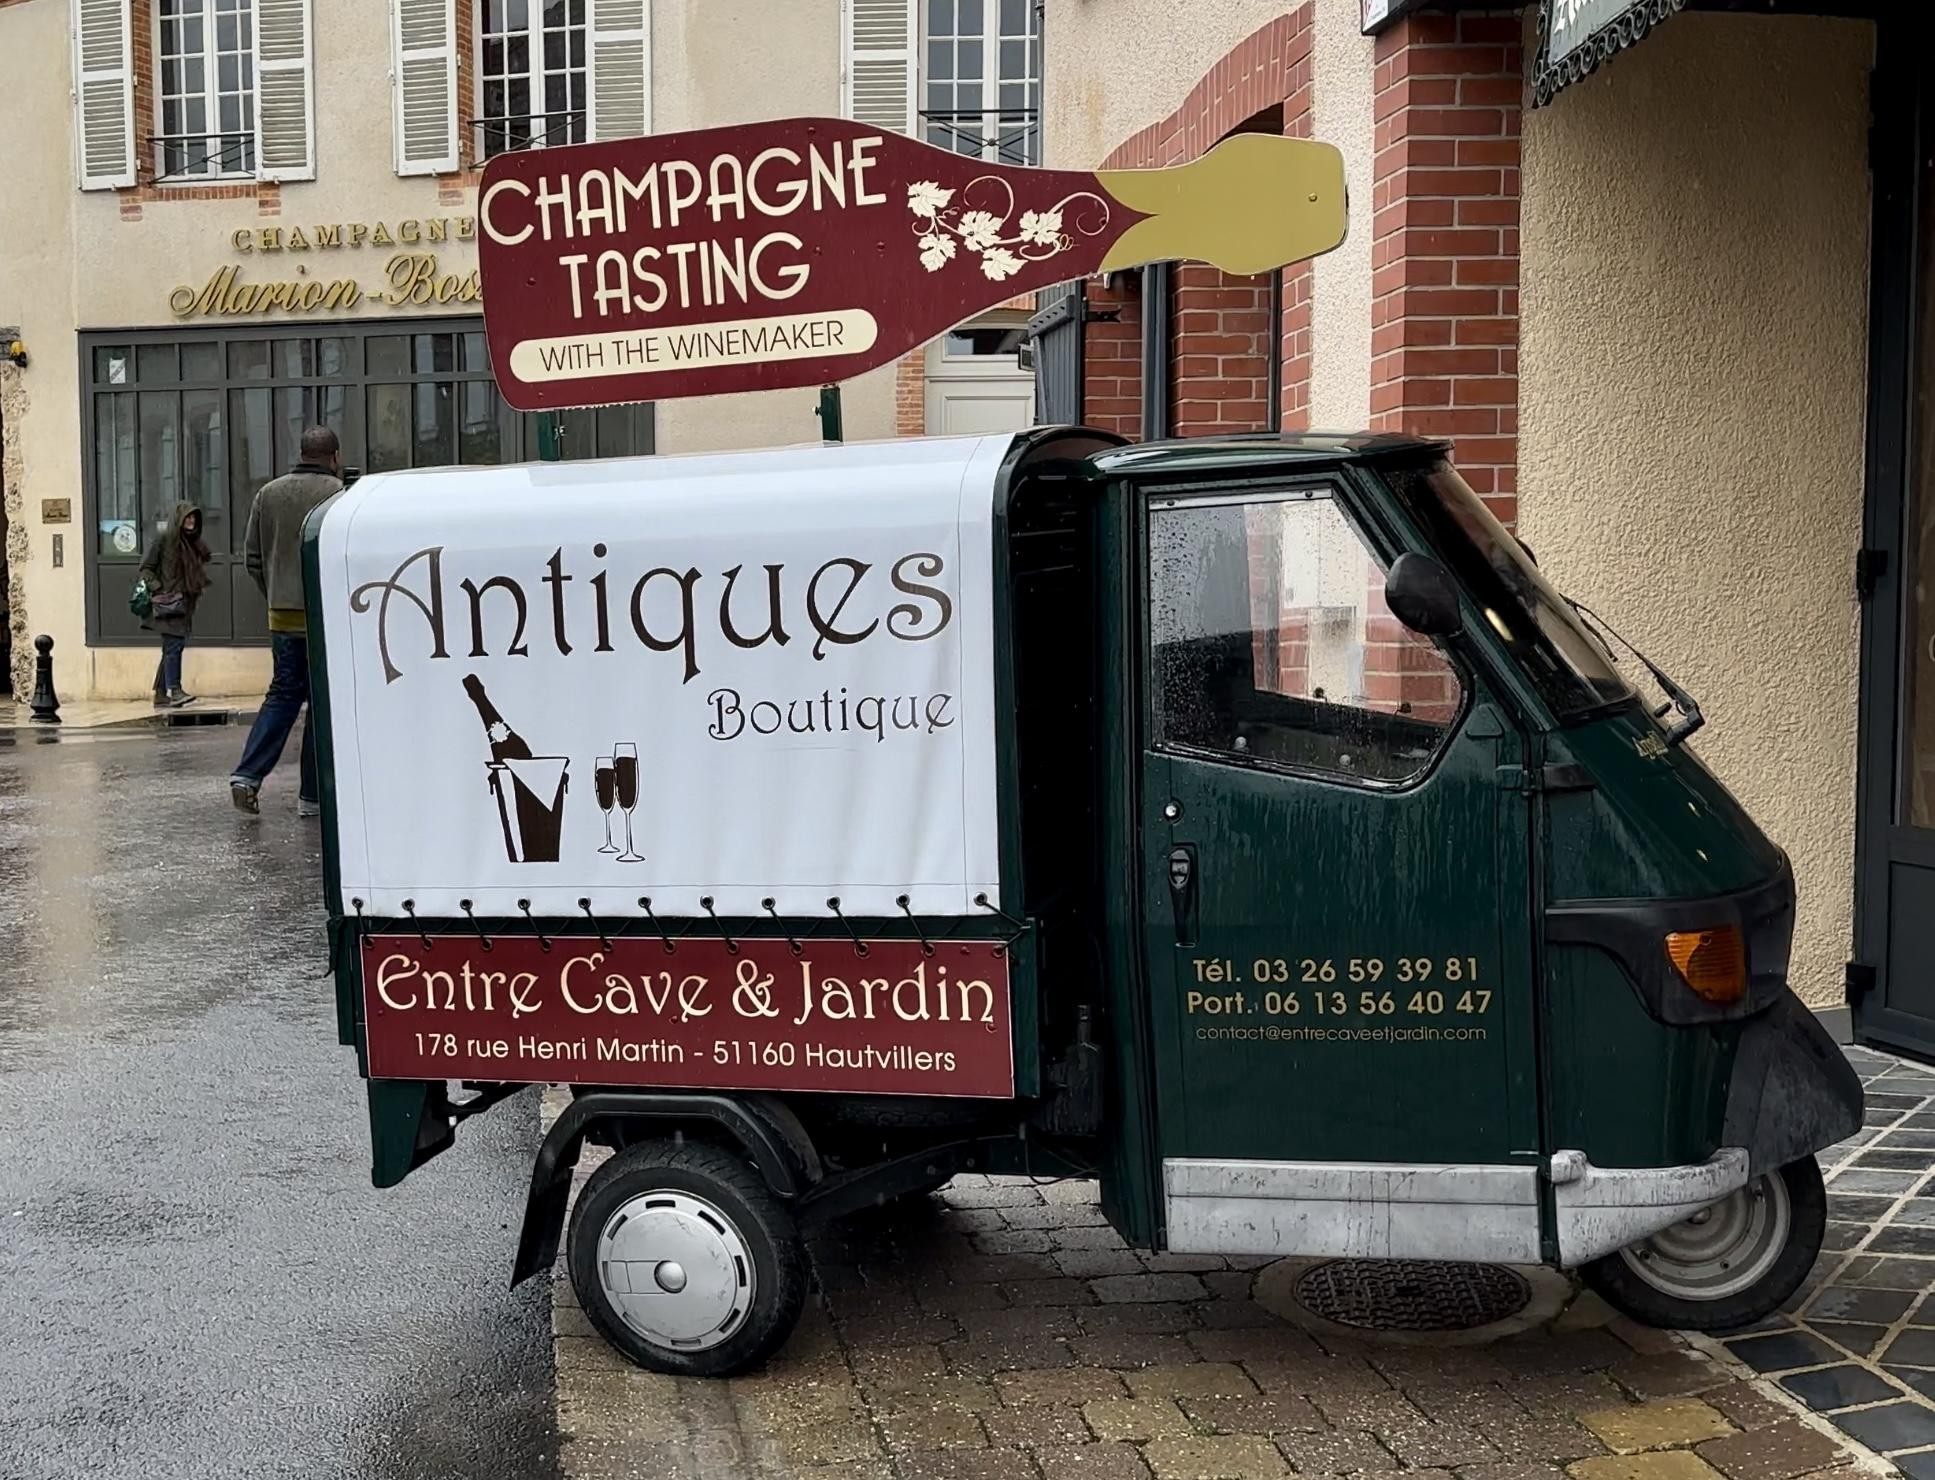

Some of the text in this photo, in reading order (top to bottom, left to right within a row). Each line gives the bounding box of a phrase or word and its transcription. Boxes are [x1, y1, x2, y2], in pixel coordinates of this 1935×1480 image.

[480, 136, 887, 246] CHAMPAGNE
[231, 216, 476, 250] CHAMPAGNE
[558, 231, 810, 319] TASTING
[539, 320, 844, 372] WITH THE WINEMAKER
[350, 542, 952, 685] Antiques
[706, 687, 955, 743] Boutique
[376, 952, 994, 1025] Entre Cave & Jardin
[1192, 957, 1477, 983] Tél. 03 26 59 39 81
[1187, 990, 1492, 1015] Port. 06 13 56 40 47
[415, 1033, 458, 1057] 178
[467, 1039, 509, 1058] rue
[518, 1035, 587, 1060] Henri
[596, 1037, 684, 1063] Martin
[713, 1040, 795, 1067] 51160
[805, 1042, 956, 1072] Hautvillers
[1195, 1025, 1487, 1044] contact@entrecaveetjardin.com
